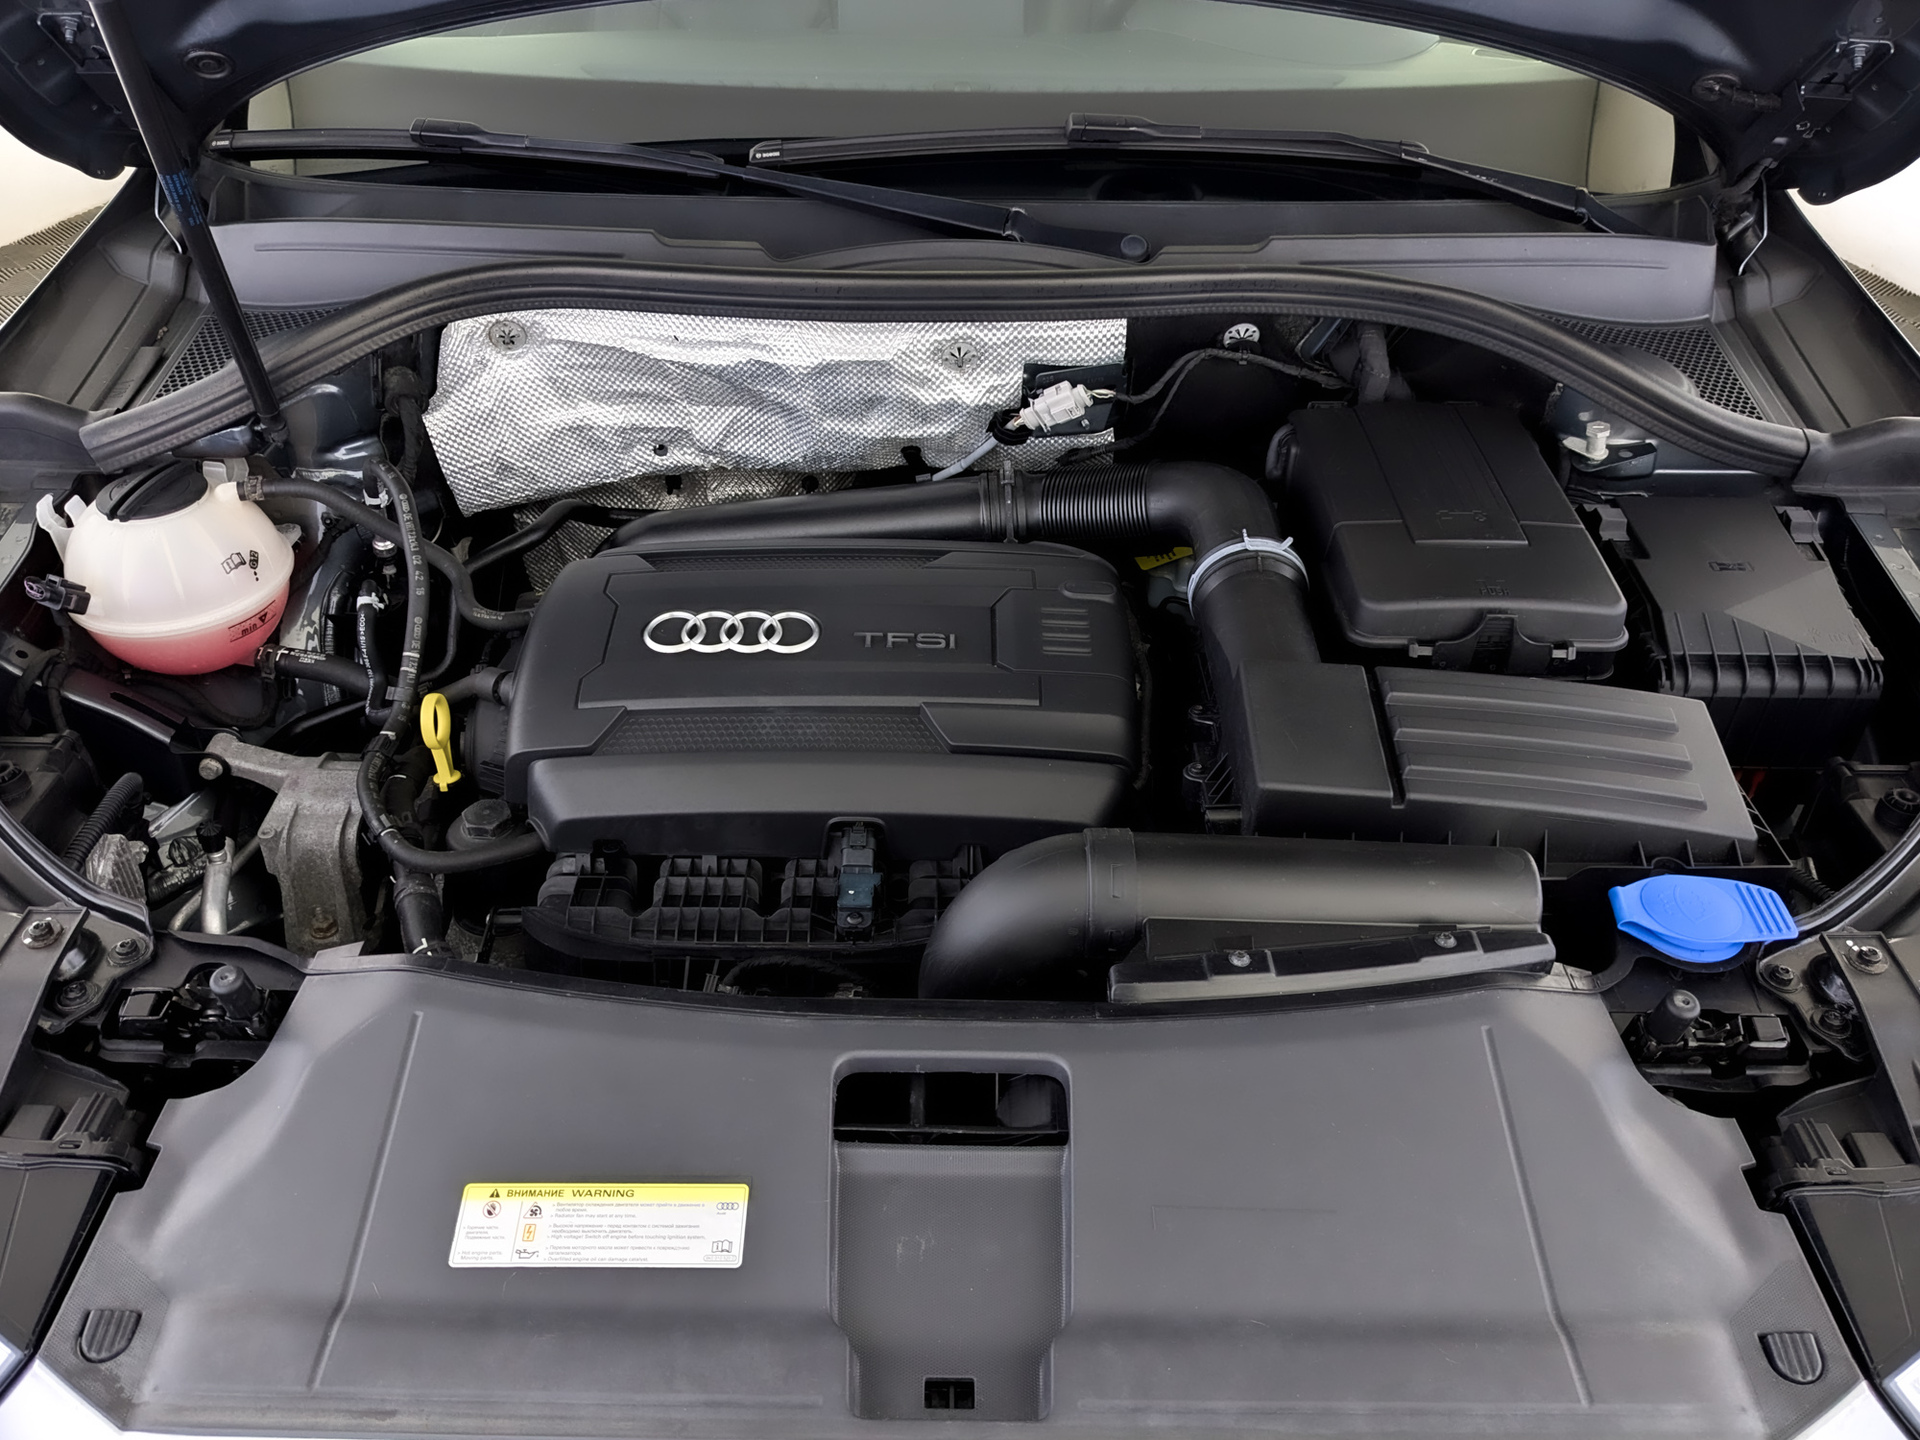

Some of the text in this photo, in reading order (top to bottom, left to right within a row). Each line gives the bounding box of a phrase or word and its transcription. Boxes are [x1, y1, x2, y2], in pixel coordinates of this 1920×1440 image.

[241, 623, 257, 636] min
[854, 632, 956, 649] TFSI
[507, 1189, 635, 1197] ВНИМАНИЕ WARNING
